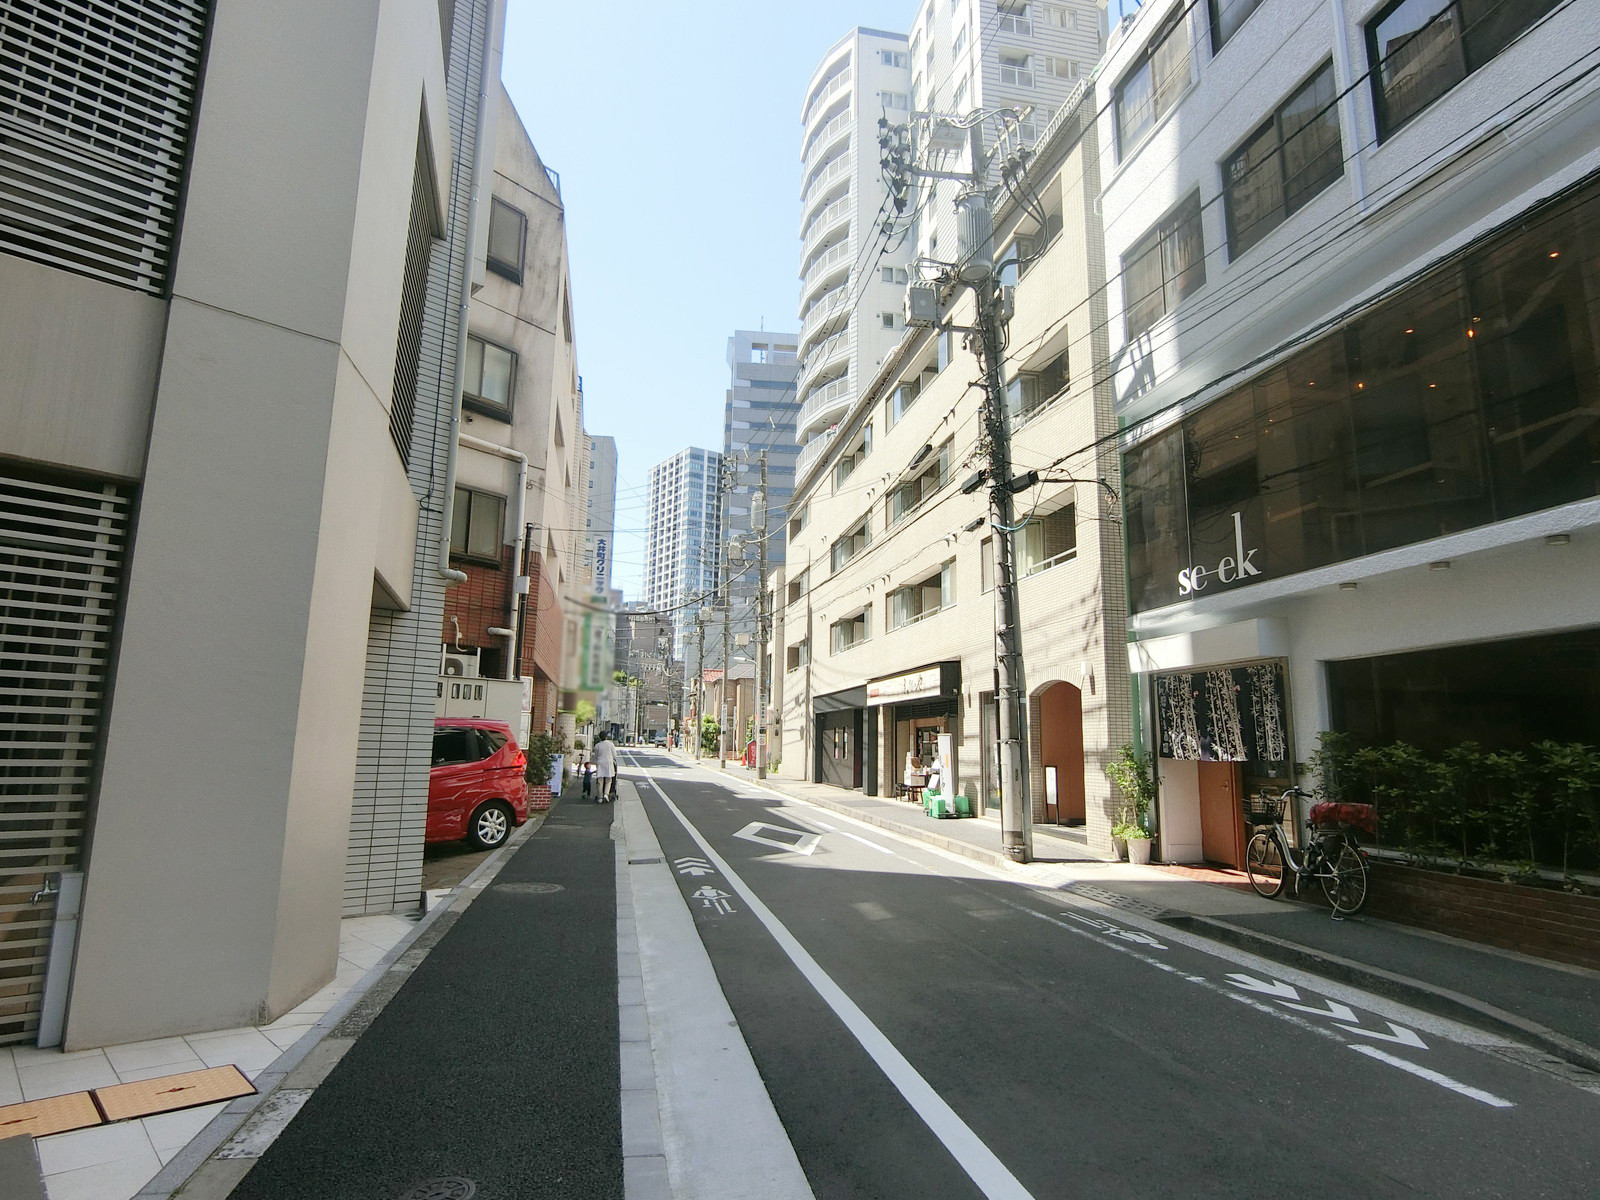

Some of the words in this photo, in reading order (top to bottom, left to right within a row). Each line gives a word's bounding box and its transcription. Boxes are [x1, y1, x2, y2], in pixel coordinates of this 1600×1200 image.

[595, 538, 607, 594] 大井町クリニック
